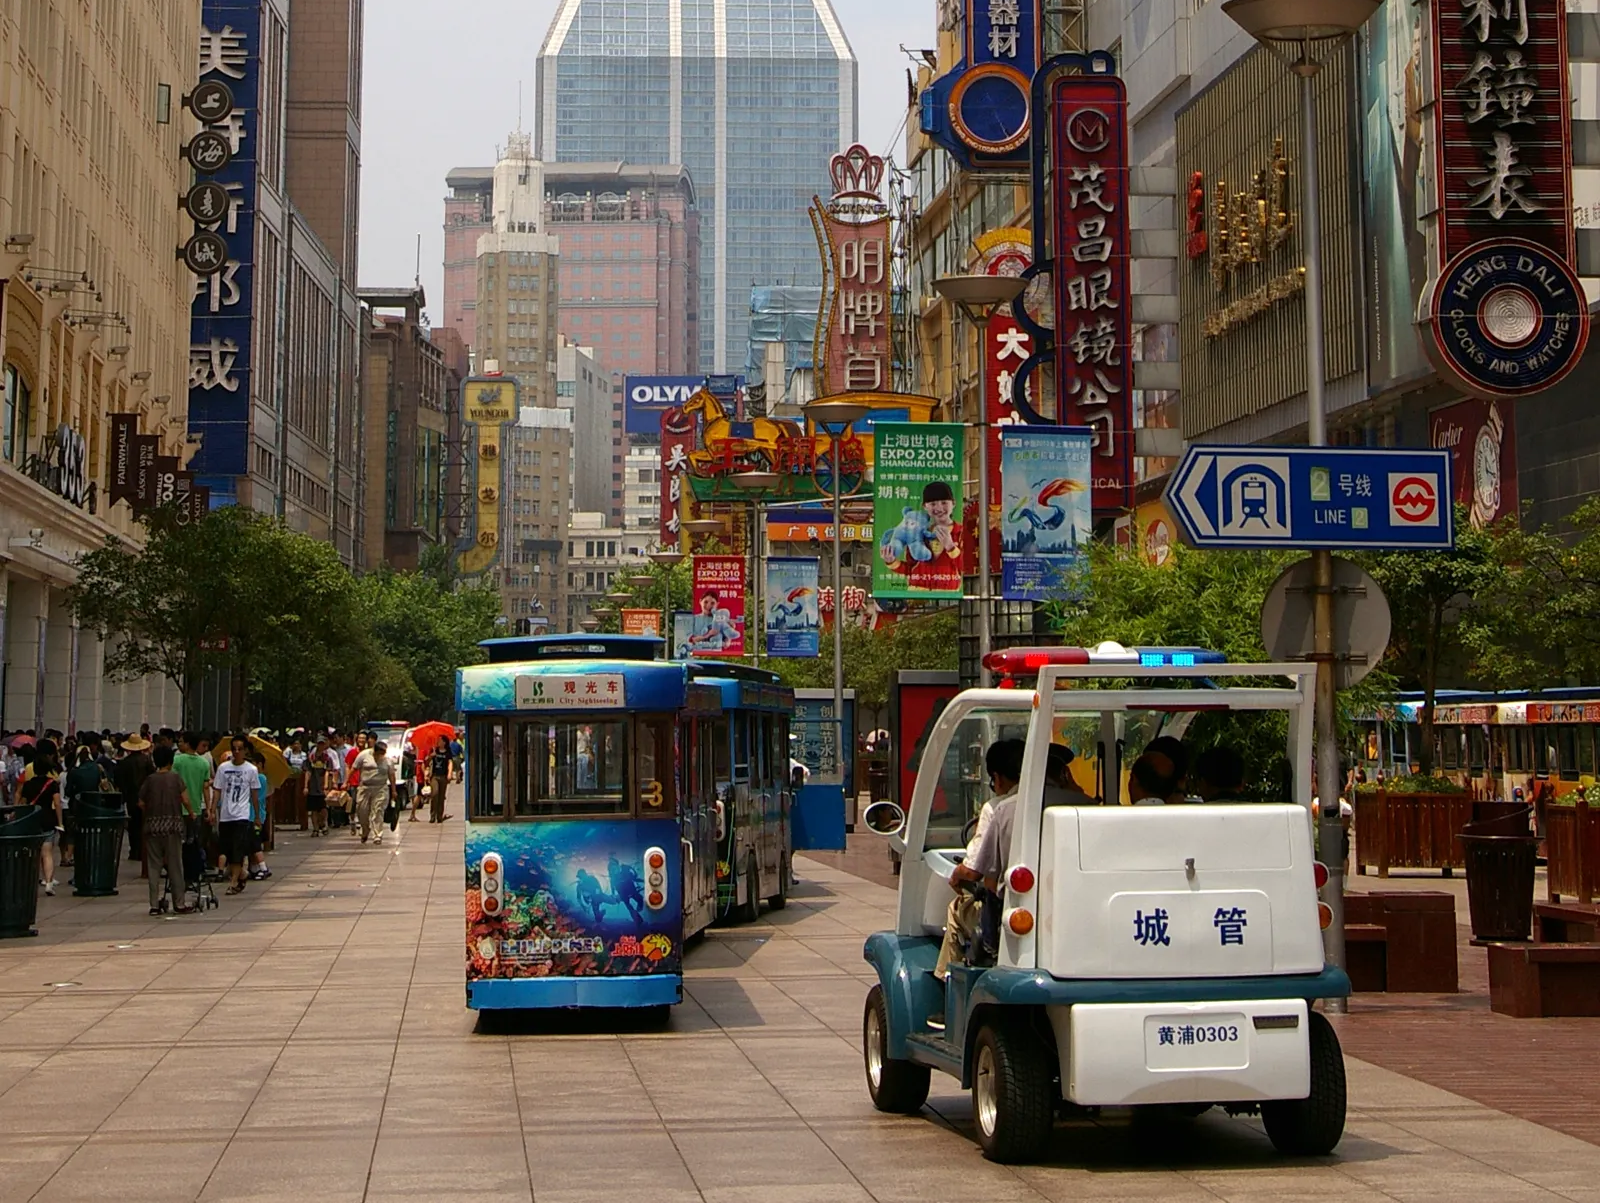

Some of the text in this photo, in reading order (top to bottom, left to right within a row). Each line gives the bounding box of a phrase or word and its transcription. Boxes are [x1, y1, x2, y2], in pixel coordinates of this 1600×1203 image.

[189, 24, 248, 392] 美邦威
[1453, 255, 1566, 299] HENG DALI
[1450, 309, 1570, 374] CLOCKS AND WATCHES
[469, 407, 510, 420] YOUNGOR
[880, 434, 954, 448] 上海世博会
[1432, 417, 1464, 449] Cartier
[117, 423, 128, 485] FAIRWHALE
[139, 444, 147, 467] WIND
[880, 449, 954, 460] EXPO 2010
[880, 460, 954, 469] SHANGHAI CHINA
[163, 473, 175, 502] OJO
[481, 443, 498, 543] 雅戈尔
[1092, 477, 1123, 490] ICAL
[1314, 509, 1365, 526] LINE 2
[788, 526, 873, 538] 广告位招租
[699, 562, 740, 571] 上海世博会
[563, 680, 618, 694] 观光车
[577, 697, 618, 705] Sightseeing
[648, 781, 663, 807] 3
[1133, 907, 1247, 947] 城管
[1157, 1025, 1239, 1046] 黄浦0303
